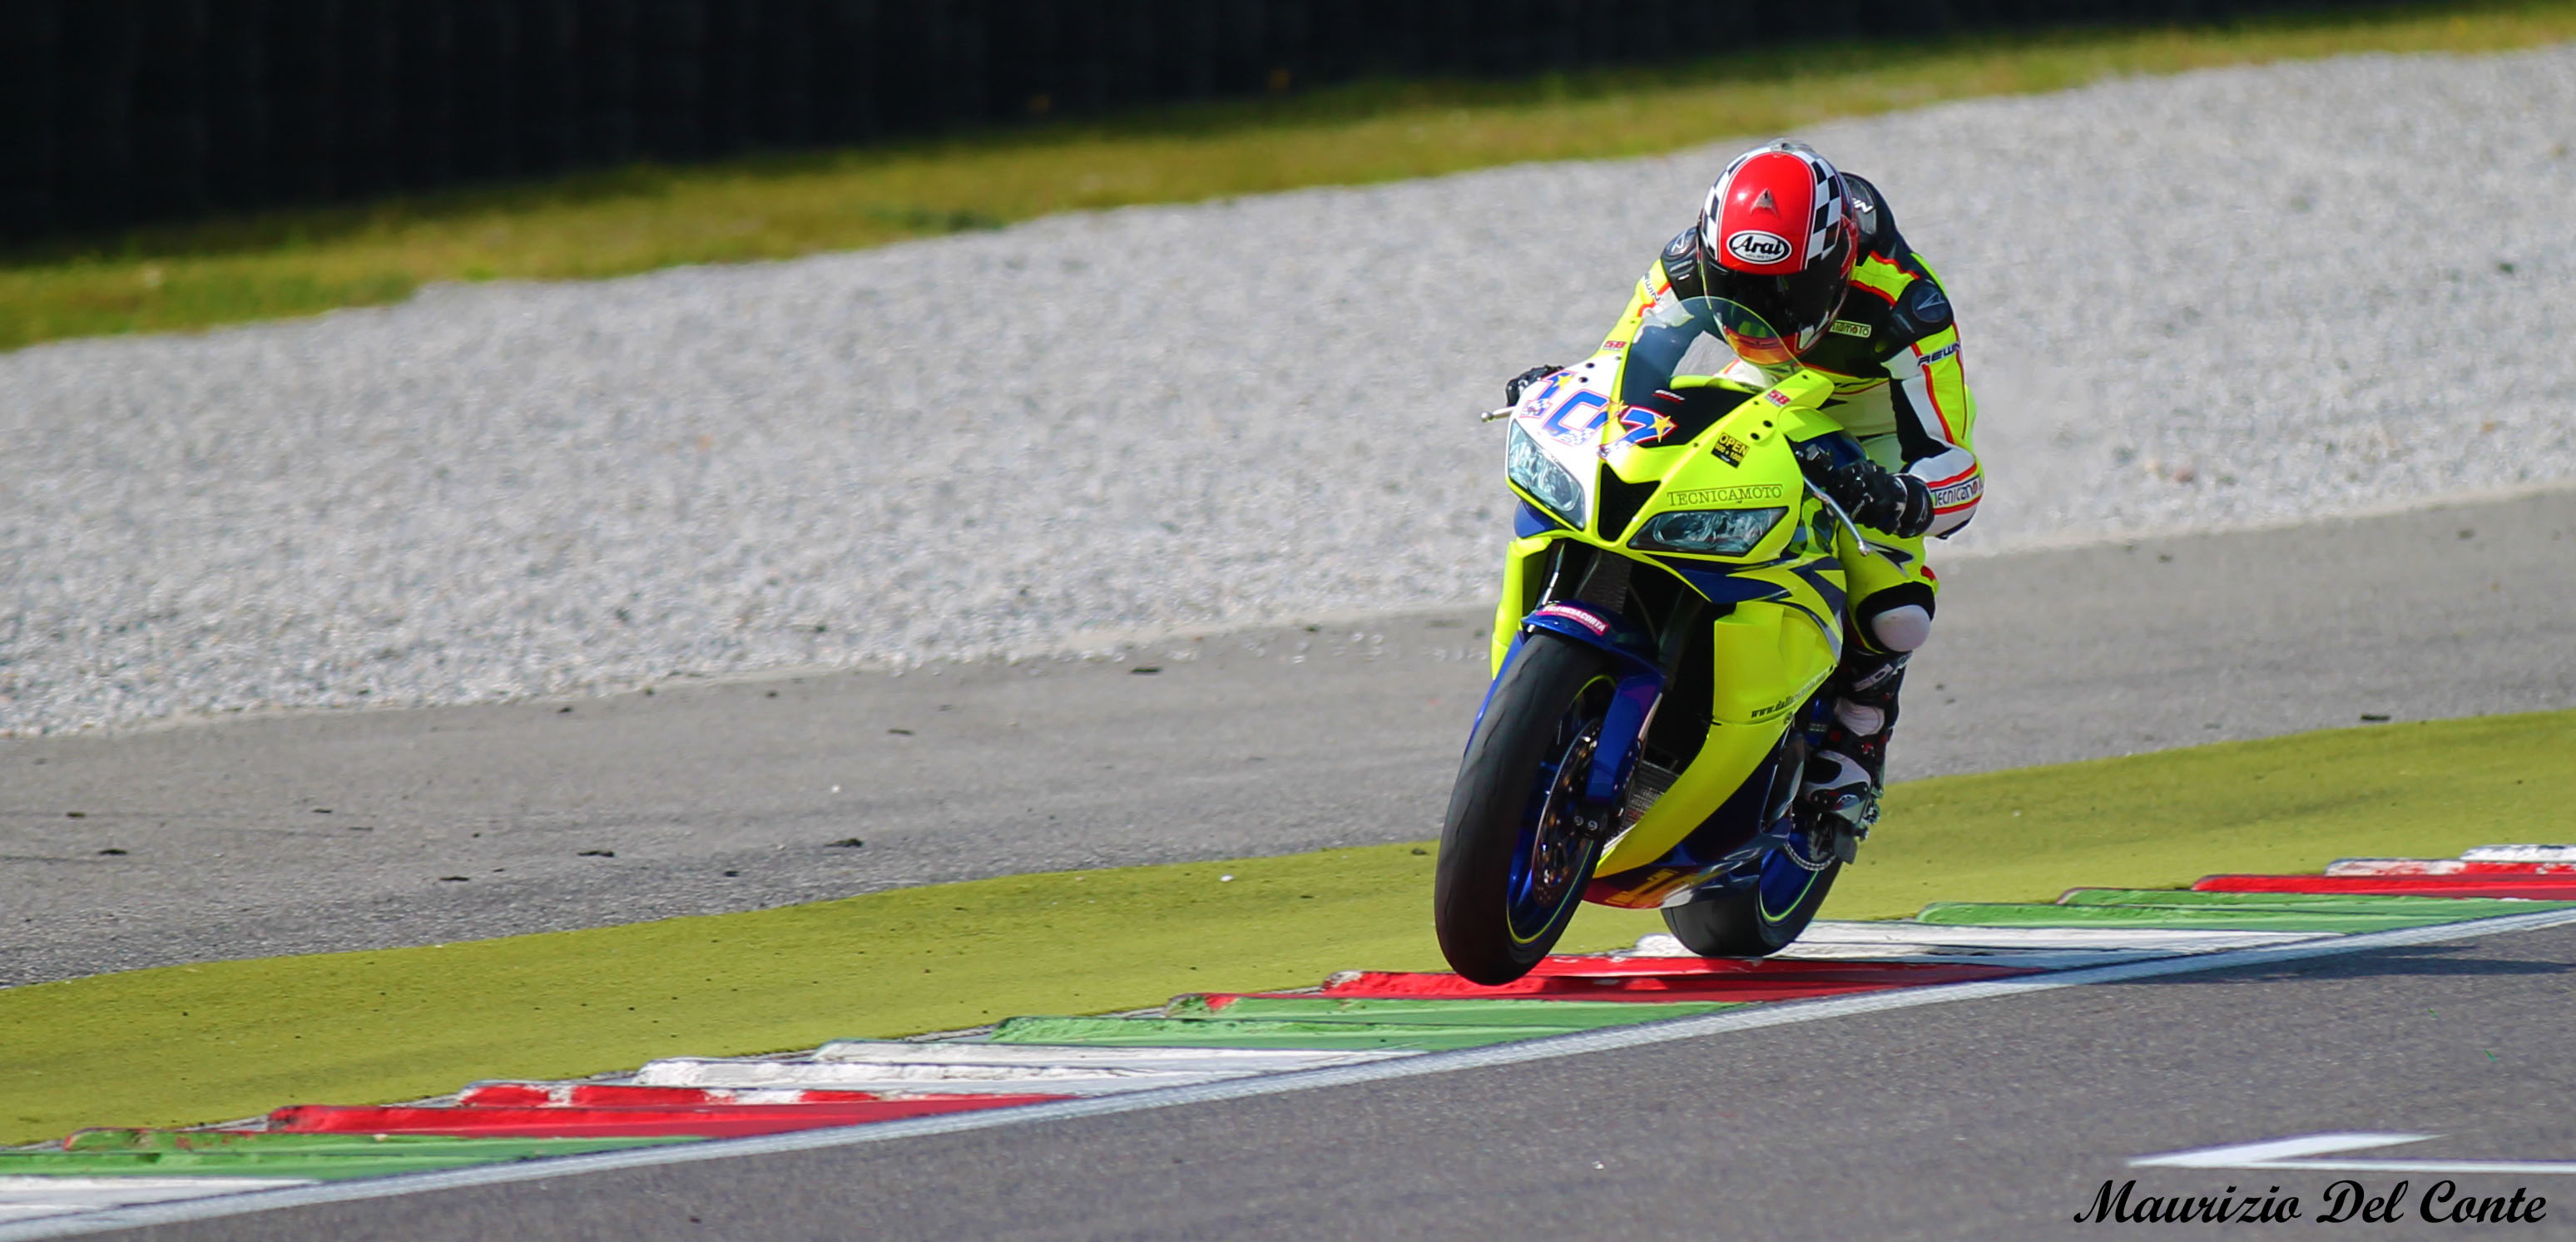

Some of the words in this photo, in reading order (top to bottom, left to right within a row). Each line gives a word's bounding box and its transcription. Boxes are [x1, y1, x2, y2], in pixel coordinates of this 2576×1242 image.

[1731, 235, 1783, 255] Arai
[1719, 433, 1749, 456] OPEN
[1667, 483, 1783, 506] TECNICAMOTO
